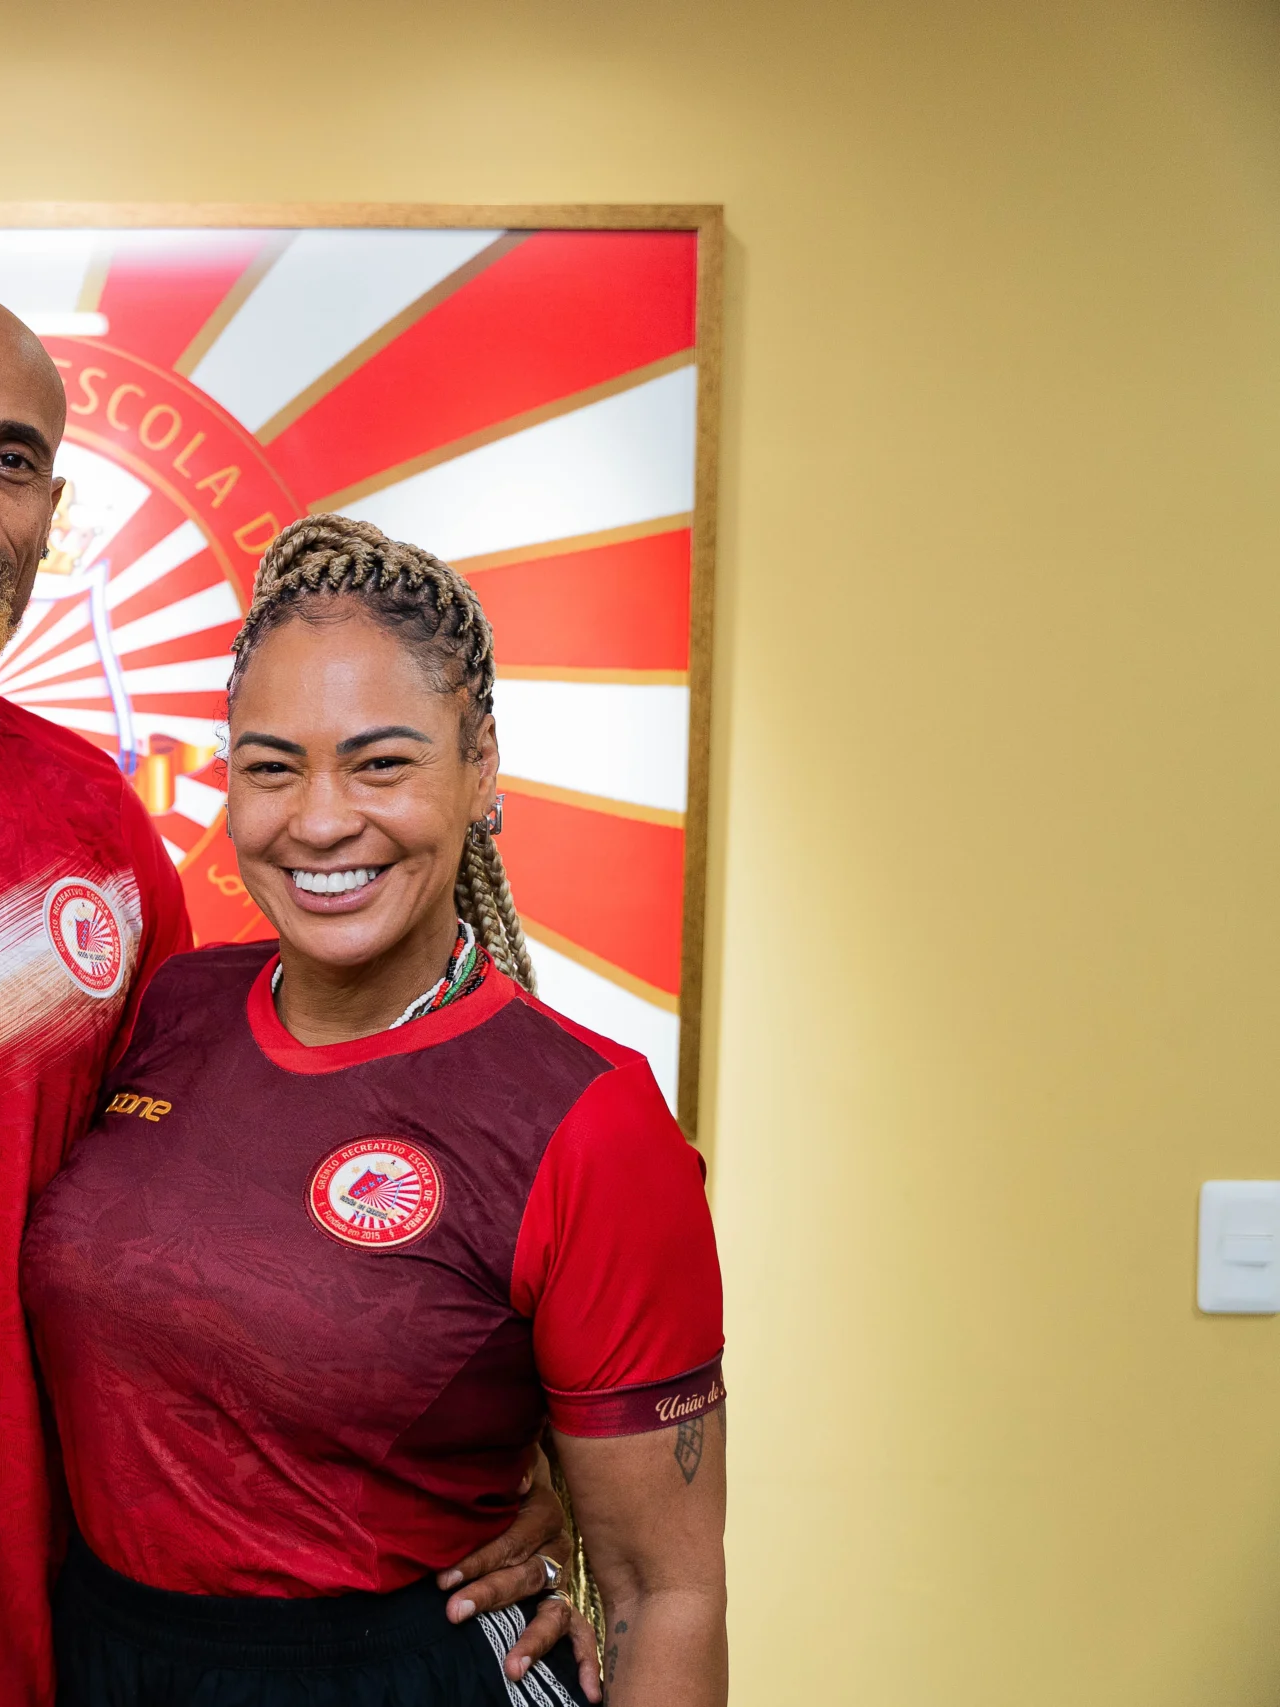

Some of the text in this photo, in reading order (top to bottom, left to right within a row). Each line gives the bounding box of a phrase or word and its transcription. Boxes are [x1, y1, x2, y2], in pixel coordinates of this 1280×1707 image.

[232, 512, 282, 556] D
[342, 1142, 405, 1160] RECREATIVO
[408, 1153, 433, 1185] ESCOLA
[423, 1189, 433, 1202] DE
[323, 1209, 348, 1233] Fundada
[361, 1231, 380, 1240] 2015
[402, 1206, 429, 1231] SAMBA
[655, 1394, 705, 1421] União
[708, 1380, 718, 1404] de
